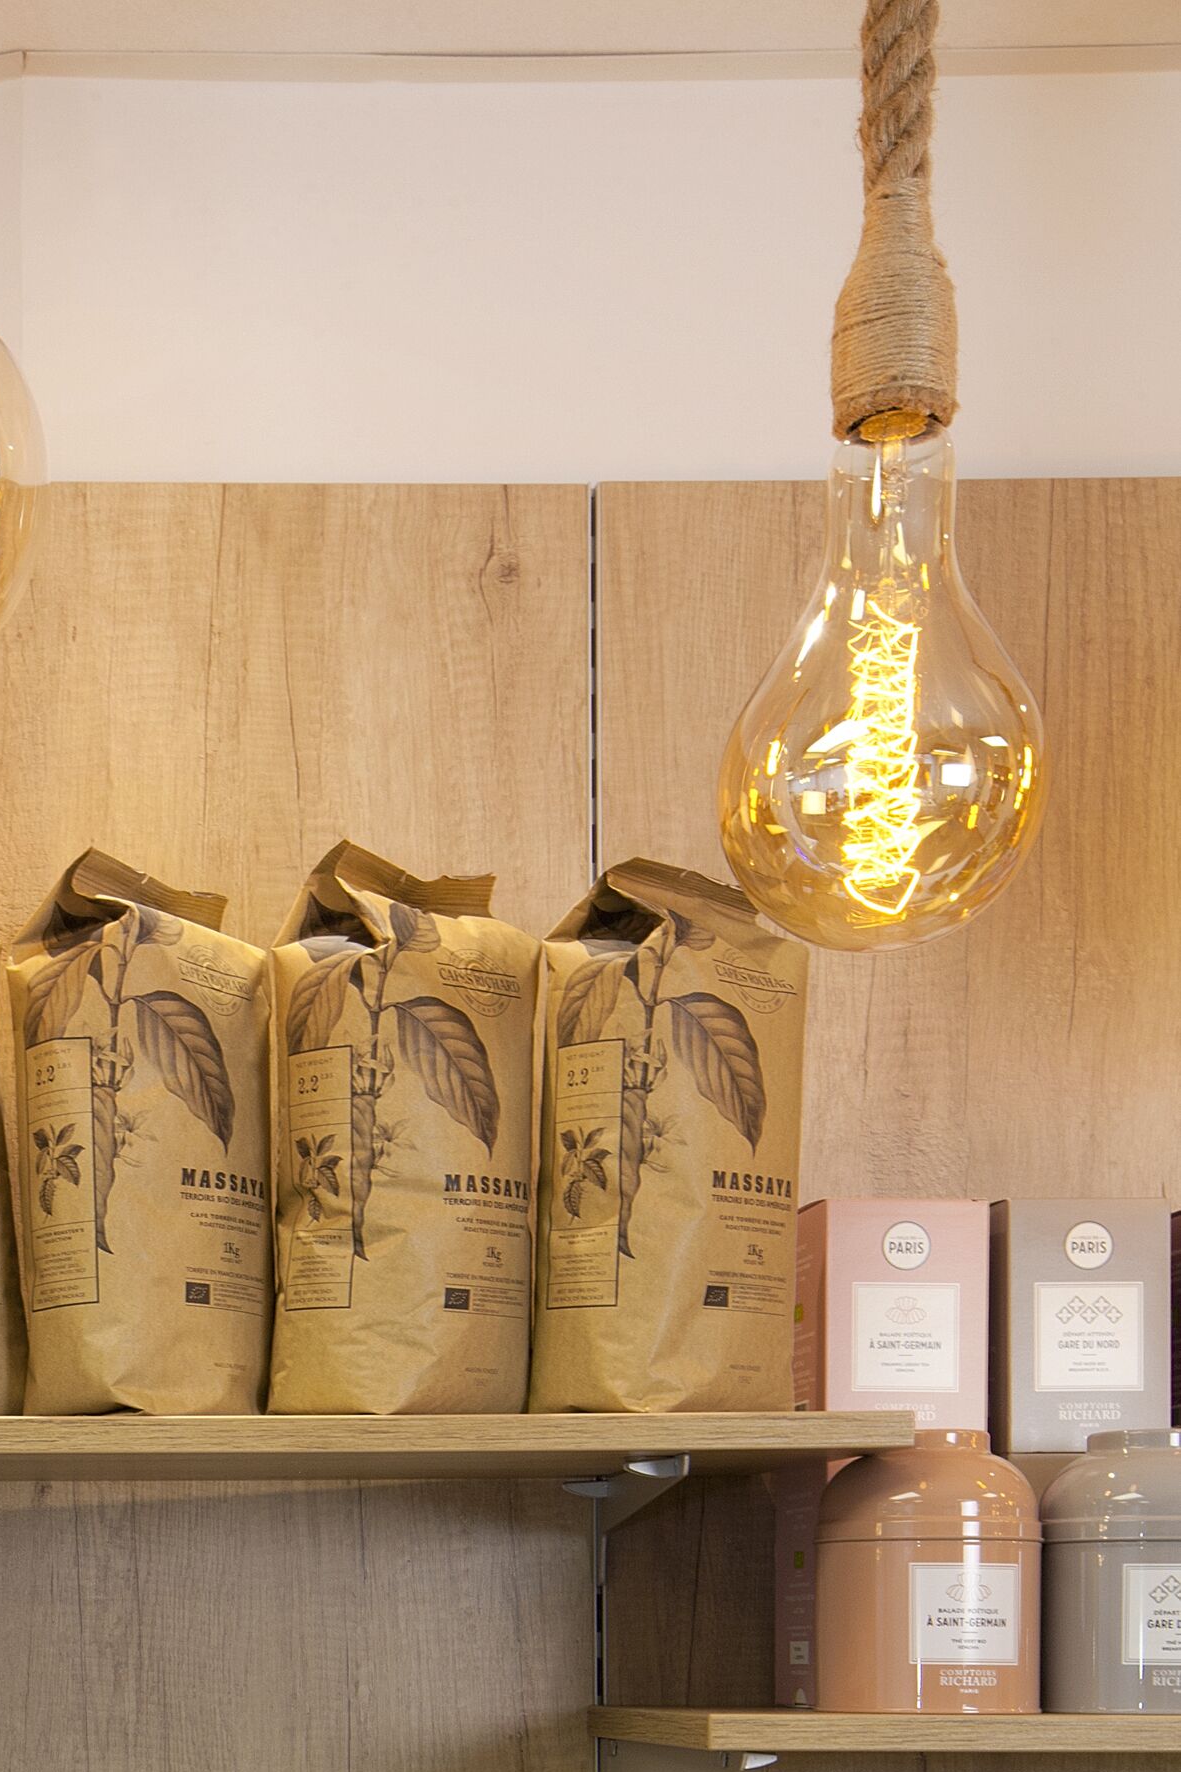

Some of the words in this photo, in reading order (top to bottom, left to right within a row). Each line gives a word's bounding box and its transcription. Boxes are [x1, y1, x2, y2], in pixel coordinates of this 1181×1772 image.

[36, 1065, 55, 1086] 2.2
[567, 1067, 589, 1087] 2.2
[298, 1075, 319, 1095] 2.2
[181, 1167, 265, 1200] MASSAYA
[444, 1174, 528, 1201] MASSAYA
[712, 1170, 792, 1198] MASSAYA
[180, 1191, 215, 1203] TERROIRS
[443, 1197, 481, 1207] TERROIRS
[223, 1241, 240, 1258] 1Kg
[889, 1241, 924, 1255] PARIS
[1071, 1241, 1107, 1254] PARIS
[869, 1338, 875, 1349] À
[877, 1340, 942, 1350] SAINT-GERMAIN
[1058, 1340, 1080, 1349] GARE
[1082, 1340, 1094, 1349] DU
[1097, 1340, 1120, 1350] NORD
[1058, 1409, 1121, 1421] RICHARD
[927, 1615, 933, 1627] À
[936, 1617, 1007, 1628] SAINT-GERMAIN
[1147, 1619, 1174, 1629] GARE
[940, 1676, 997, 1687] RICHARD
